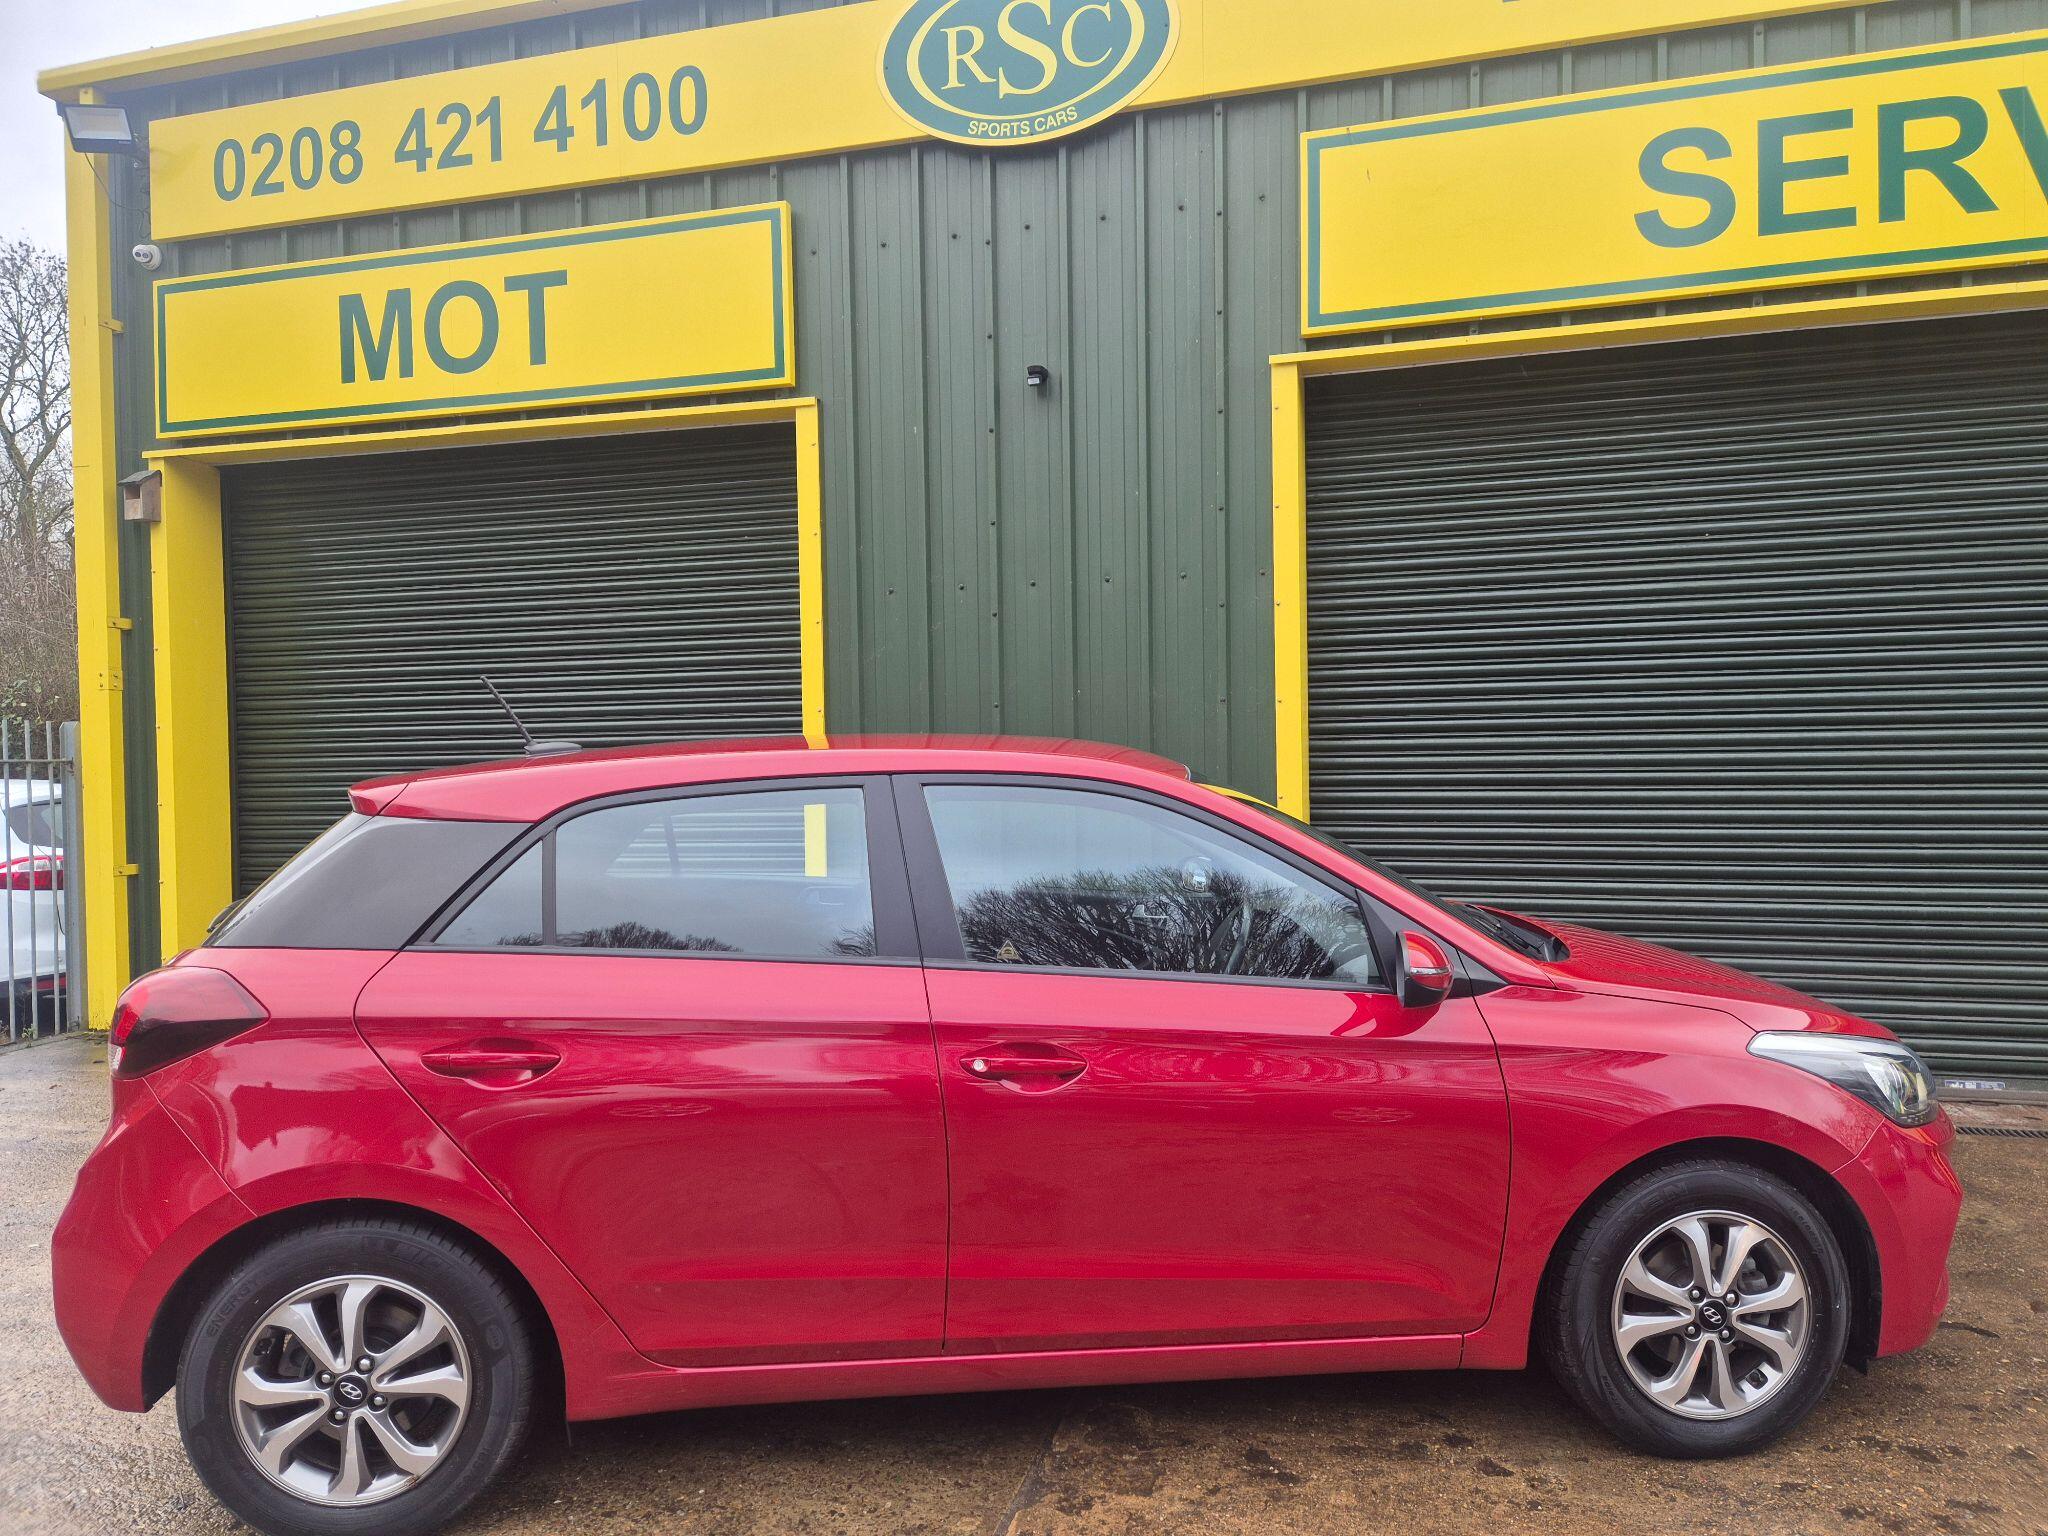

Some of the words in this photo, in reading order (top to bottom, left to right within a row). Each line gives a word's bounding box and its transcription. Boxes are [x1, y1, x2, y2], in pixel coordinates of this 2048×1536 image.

[940, 0, 1113, 99] RSC
[213, 119, 363, 202] 0208
[395, 96, 503, 173] 421
[533, 65, 709, 153] 4100
[967, 120, 1031, 137] SPORTS
[1034, 106, 1078, 132] CARS
[338, 269, 568, 384] MOT
